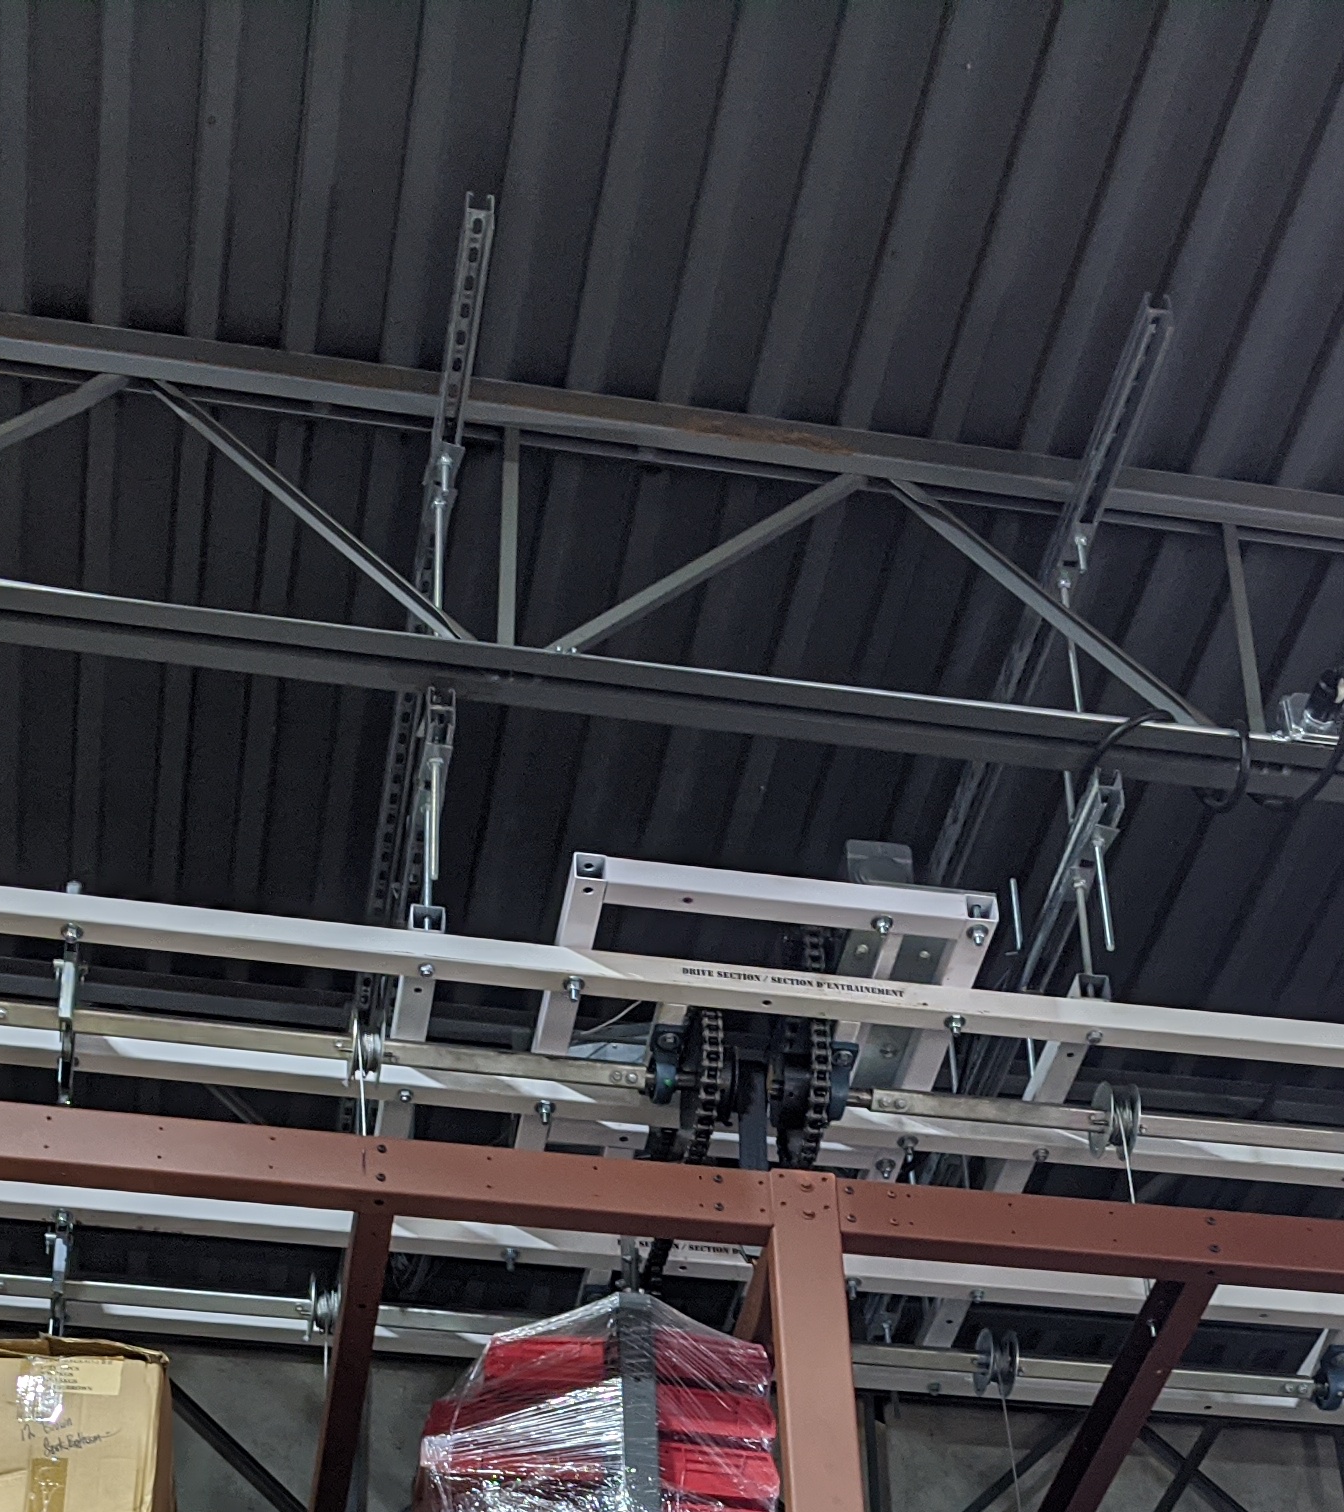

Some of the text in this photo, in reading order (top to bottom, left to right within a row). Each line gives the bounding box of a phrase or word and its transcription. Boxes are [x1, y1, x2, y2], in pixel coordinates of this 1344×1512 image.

[682, 967, 714, 977] DRIVE
[717, 970, 761, 982] SECTION
[771, 975, 813, 988] SECTION
[816, 980, 905, 998] D'ENTRAINEMENT
[688, 1244, 729, 1254] SECTION
